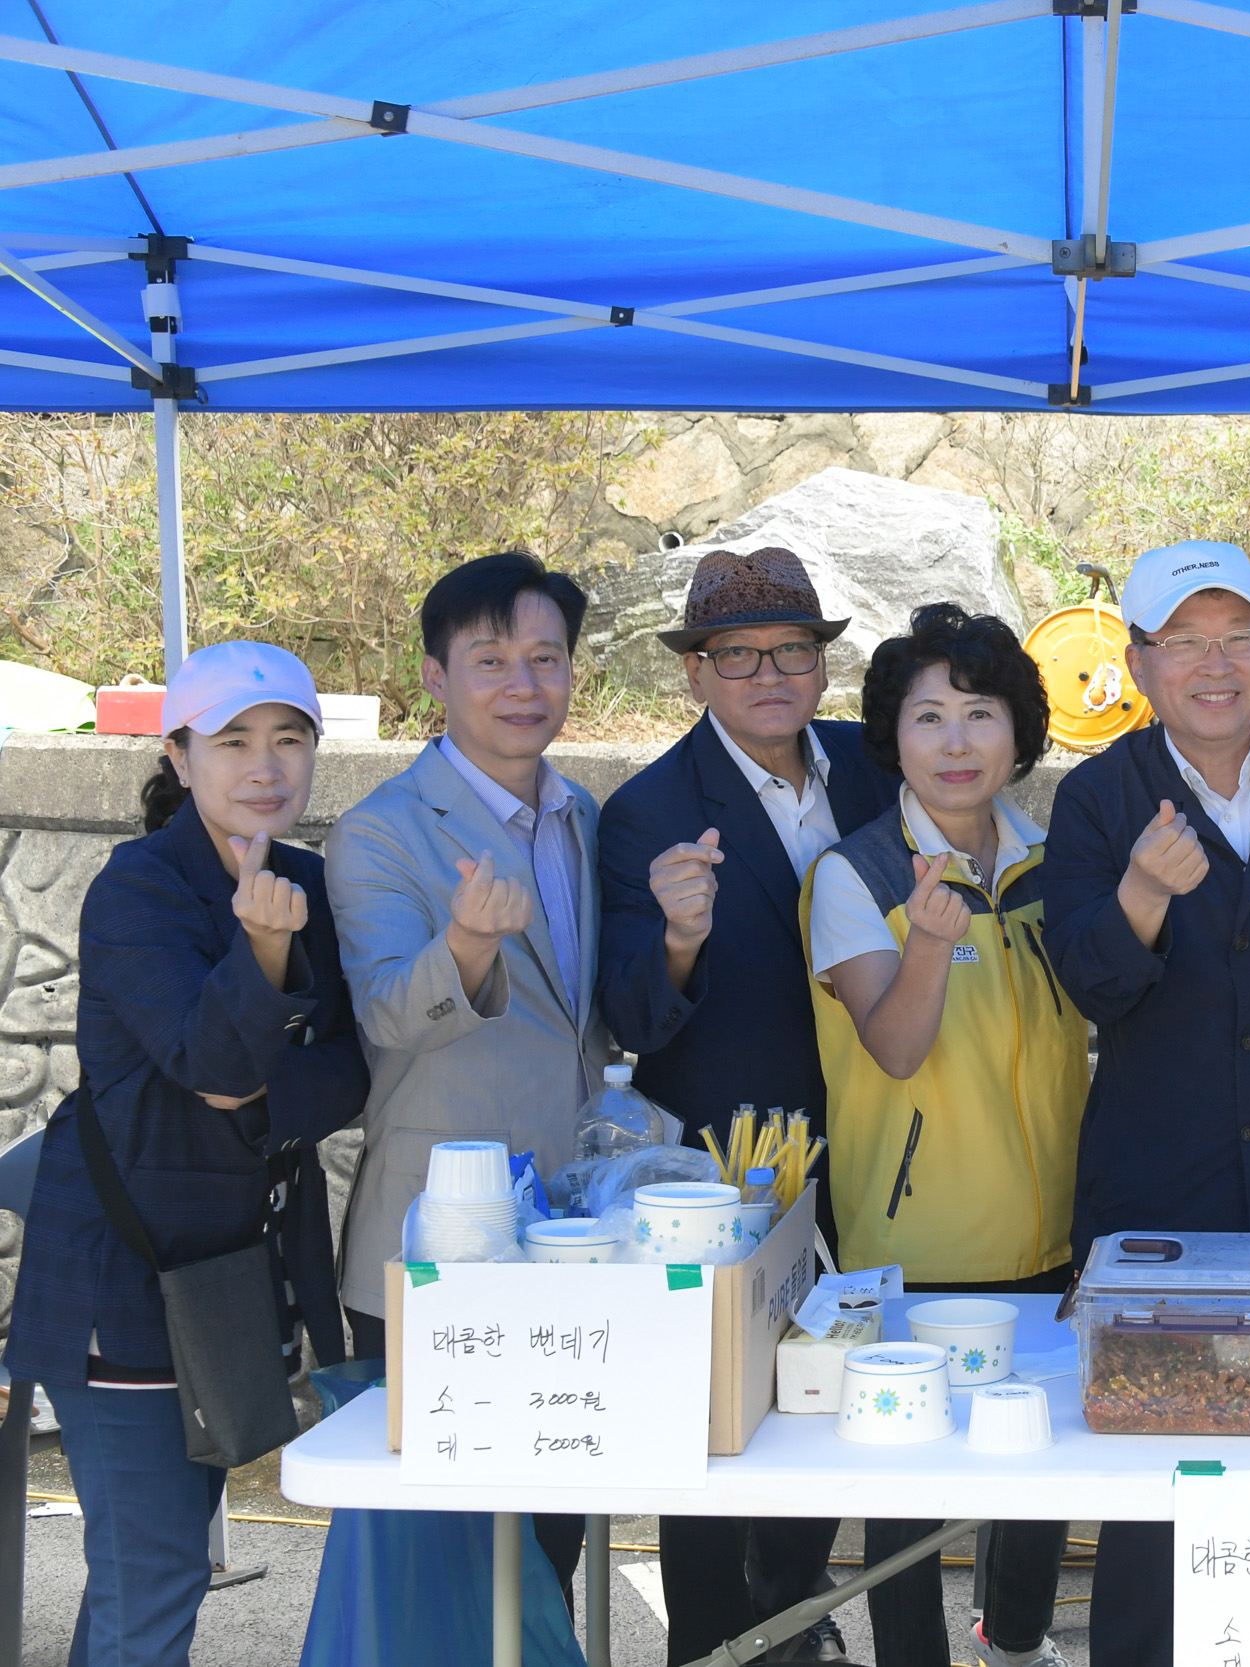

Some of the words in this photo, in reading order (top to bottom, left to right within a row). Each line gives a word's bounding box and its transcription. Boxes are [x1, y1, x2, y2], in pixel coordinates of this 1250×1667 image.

[1171, 561, 1220, 577] OTHER.NESS
[953, 945, 976, 956] 진구
[768, 1276, 790, 1330] PURE
[432, 1322, 506, 1359] 매콤한
[529, 1319, 610, 1364] 뻔데기
[825, 1320, 847, 1339] Hello!
[429, 1385, 454, 1414] 소
[528, 1391, 607, 1412] 3000원
[437, 1433, 457, 1462] 대
[533, 1430, 604, 1457] 5000원
[1214, 1617, 1243, 1646] 소
